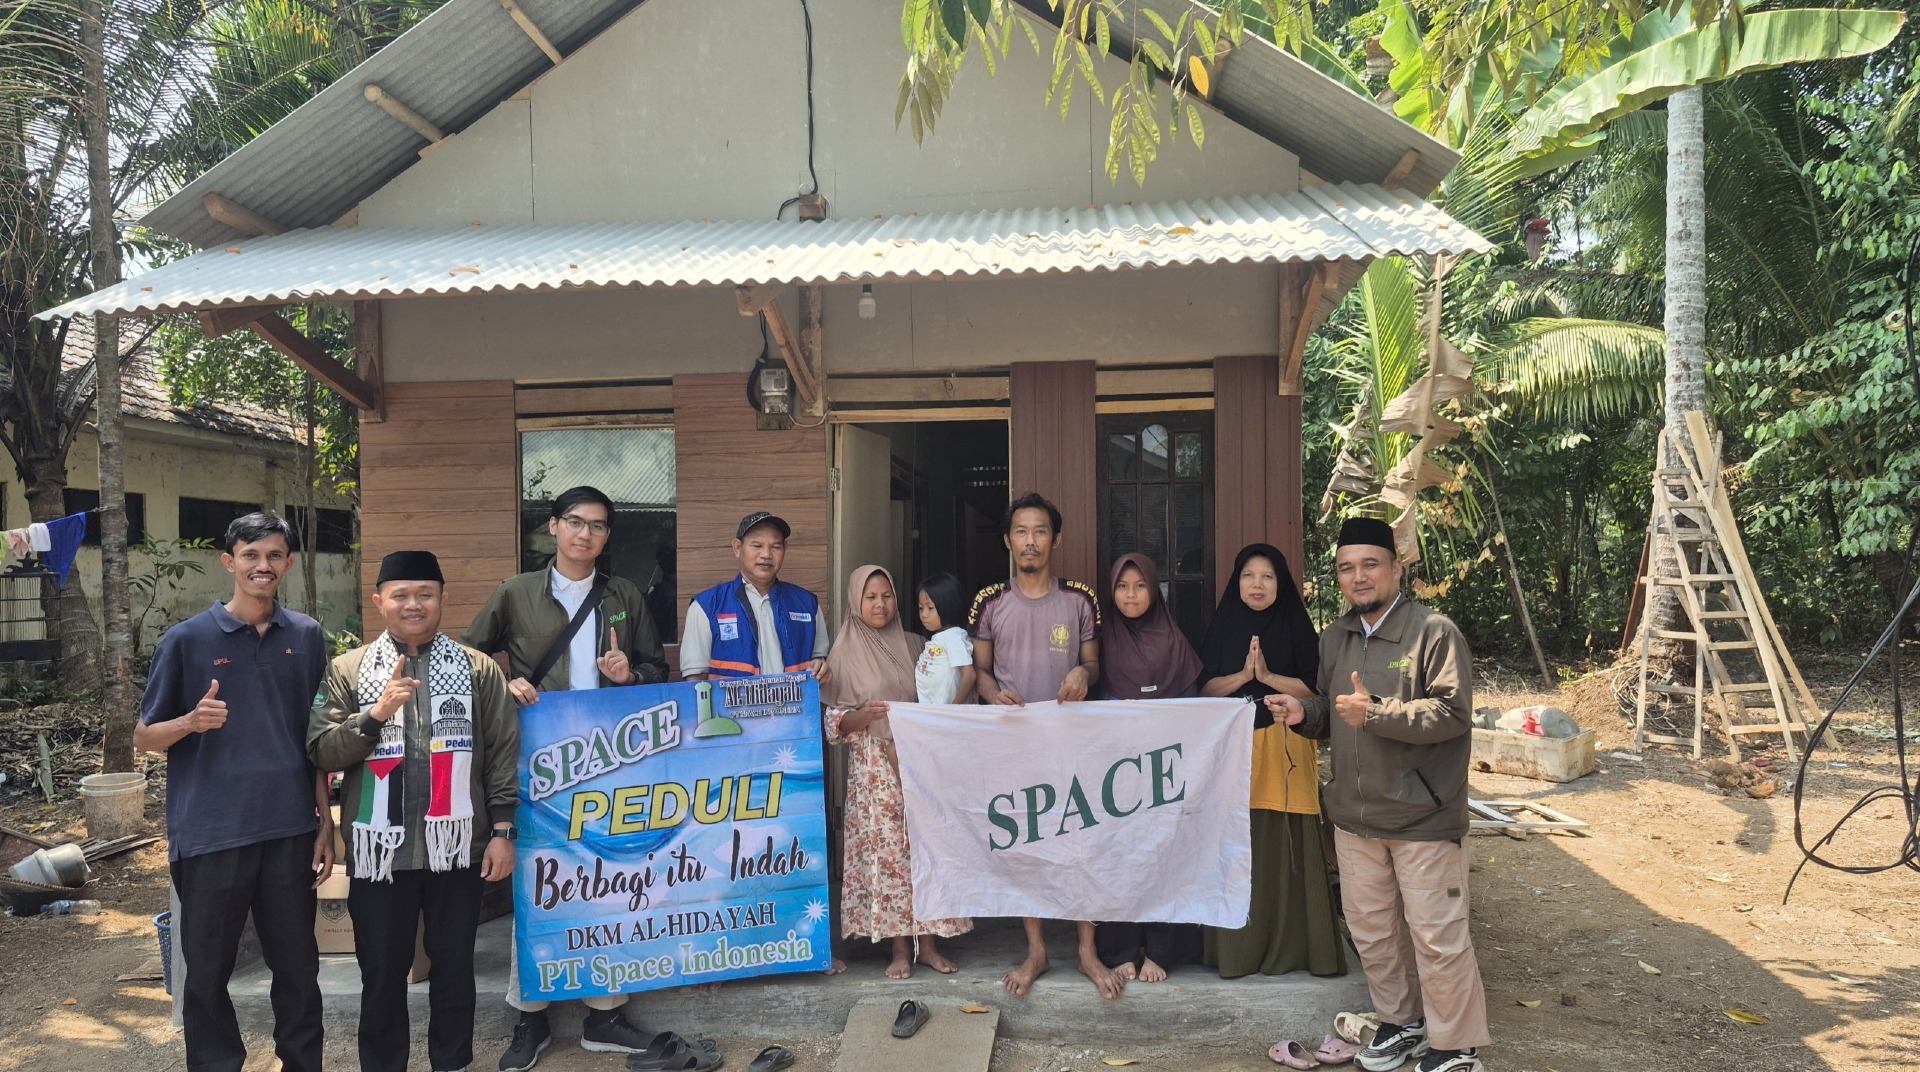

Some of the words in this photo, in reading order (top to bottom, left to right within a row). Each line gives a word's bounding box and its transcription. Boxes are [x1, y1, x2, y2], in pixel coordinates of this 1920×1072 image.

[374, 743, 403, 757] peduli
[445, 737, 472, 748] pedul
[530, 702, 679, 799] SPACE
[567, 771, 784, 841] PEDULI
[987, 743, 1187, 852] SPACE
[534, 853, 657, 912] Berbagi
[666, 843, 707, 888] itu
[730, 829, 810, 882] Indah
[566, 922, 623, 951] DKM
[630, 902, 776, 943] AL-HIDAYAH
[539, 958, 584, 992] PT
[591, 951, 675, 993] Space
[681, 930, 813, 975] Indonesia
